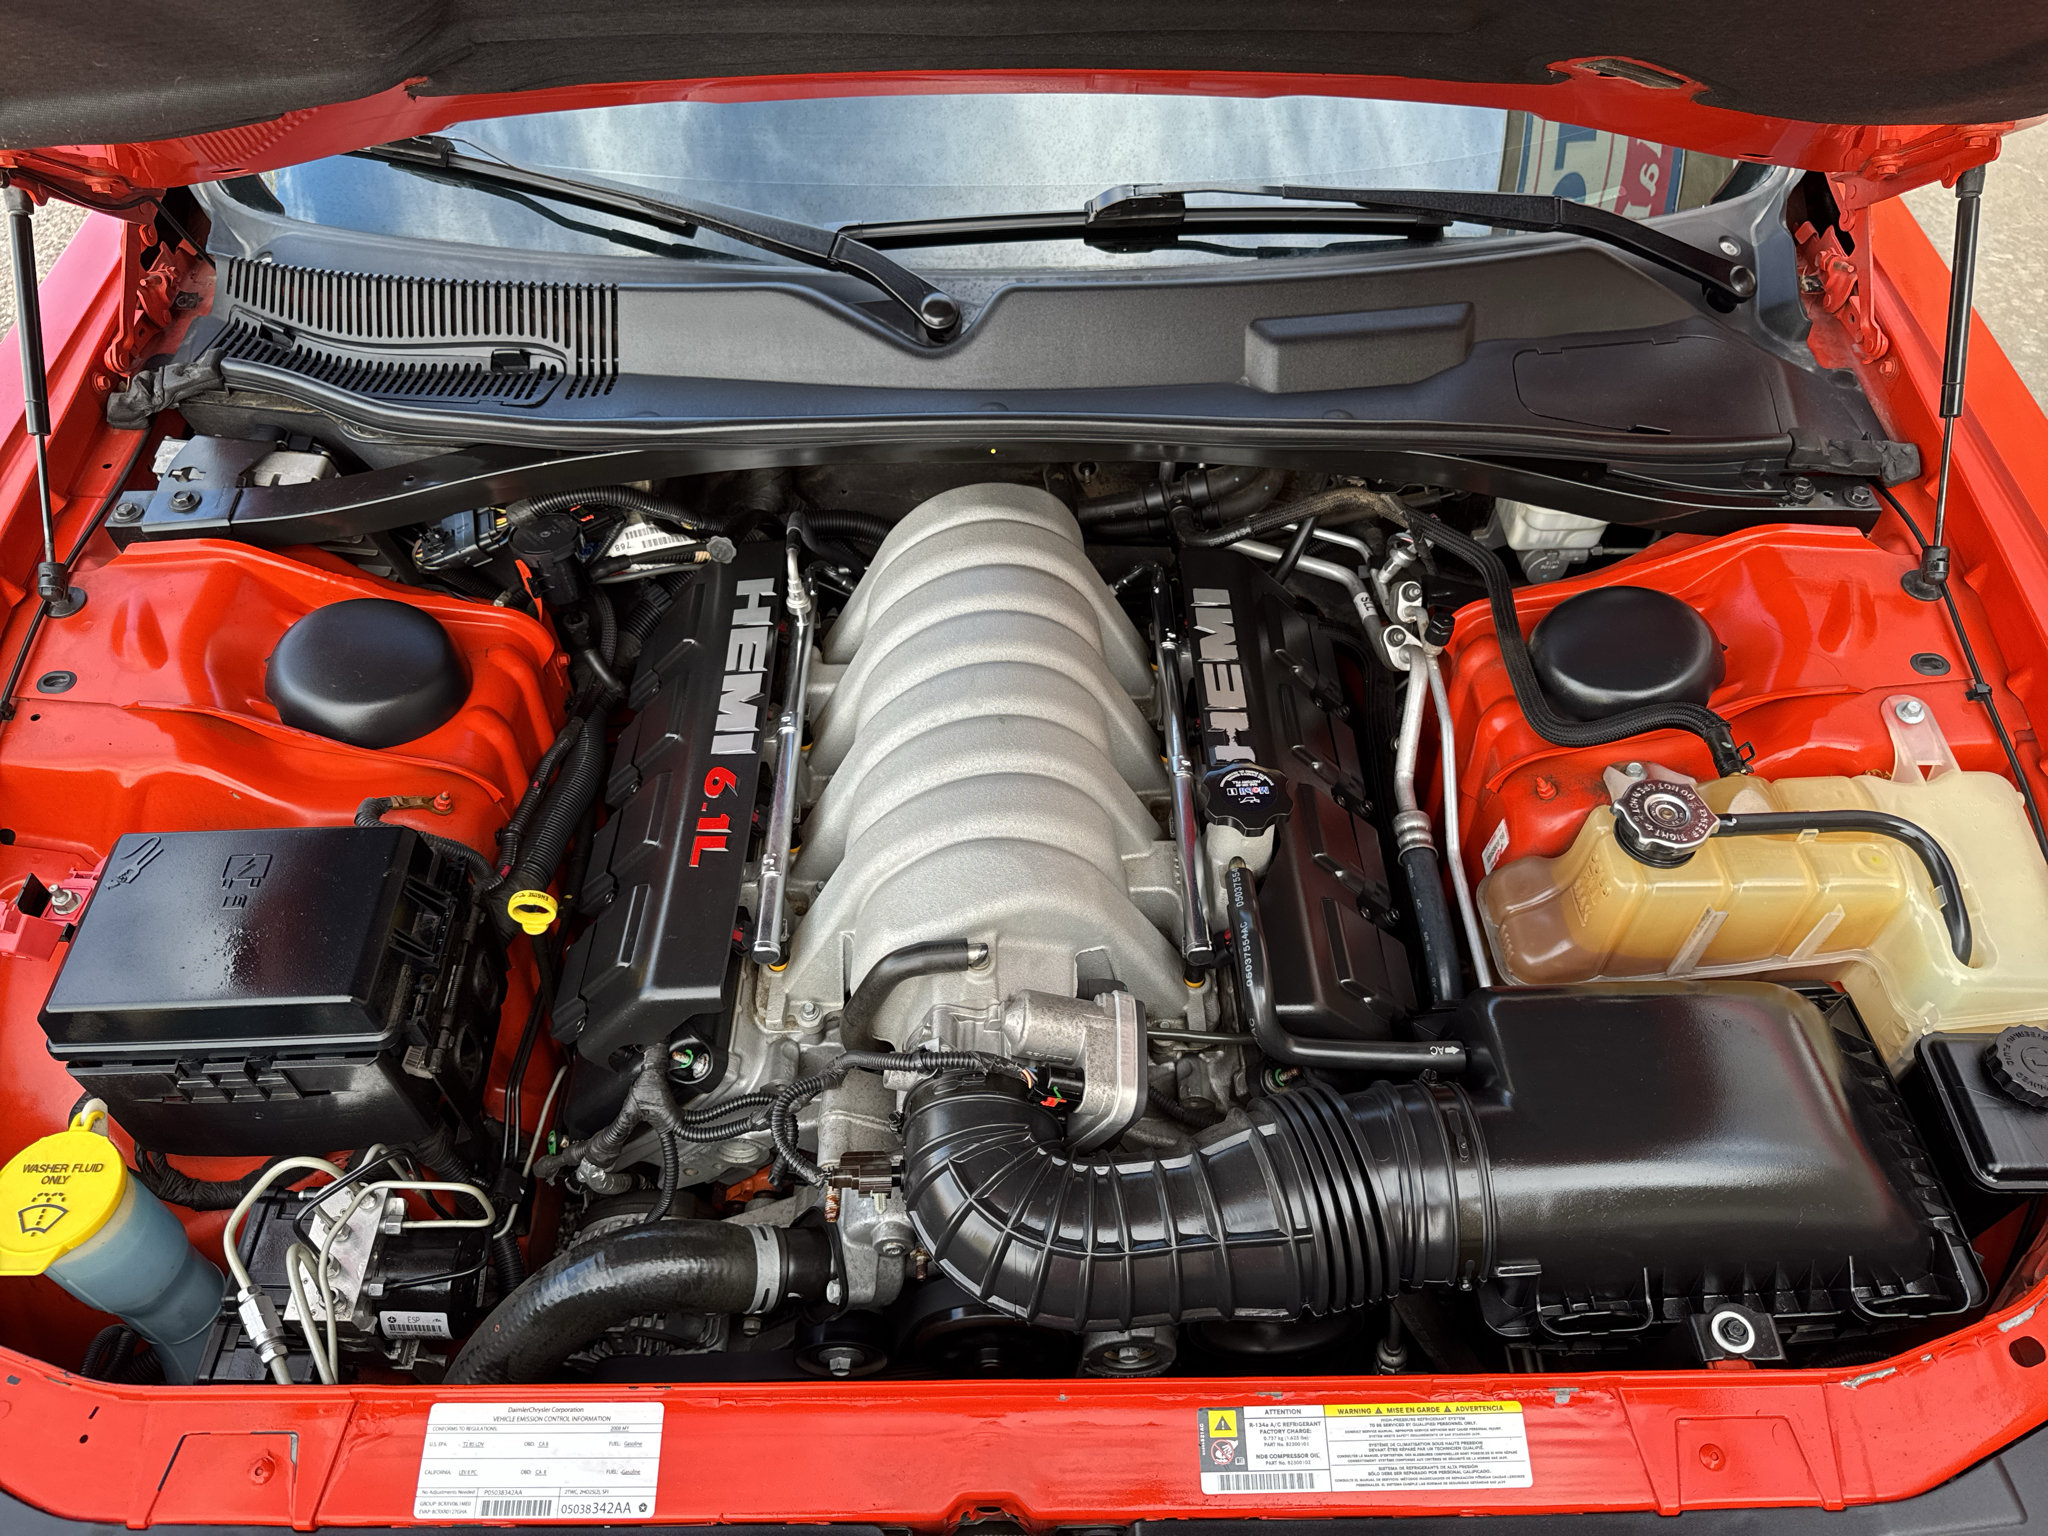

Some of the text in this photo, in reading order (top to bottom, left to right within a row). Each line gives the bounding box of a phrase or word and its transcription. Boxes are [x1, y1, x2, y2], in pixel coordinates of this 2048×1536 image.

[710, 578, 777, 754] HEMI
[1190, 588, 1256, 765] HEMI
[1238, 786, 1270, 795] Mobil
[1658, 782, 1680, 792] NOT
[1680, 790, 1696, 800] DO
[689, 766, 739, 867] 6.1L
[1240, 921, 1253, 987] 05037554AC
[1430, 1046, 1444, 1055] AC
[22, 1163, 104, 1174] WASHER FLUID
[40, 1175, 71, 1185] ONLY
[508, 1406, 551, 1414] DaimlerChrysler
[561, 1502, 631, 1514] 05038342AA
